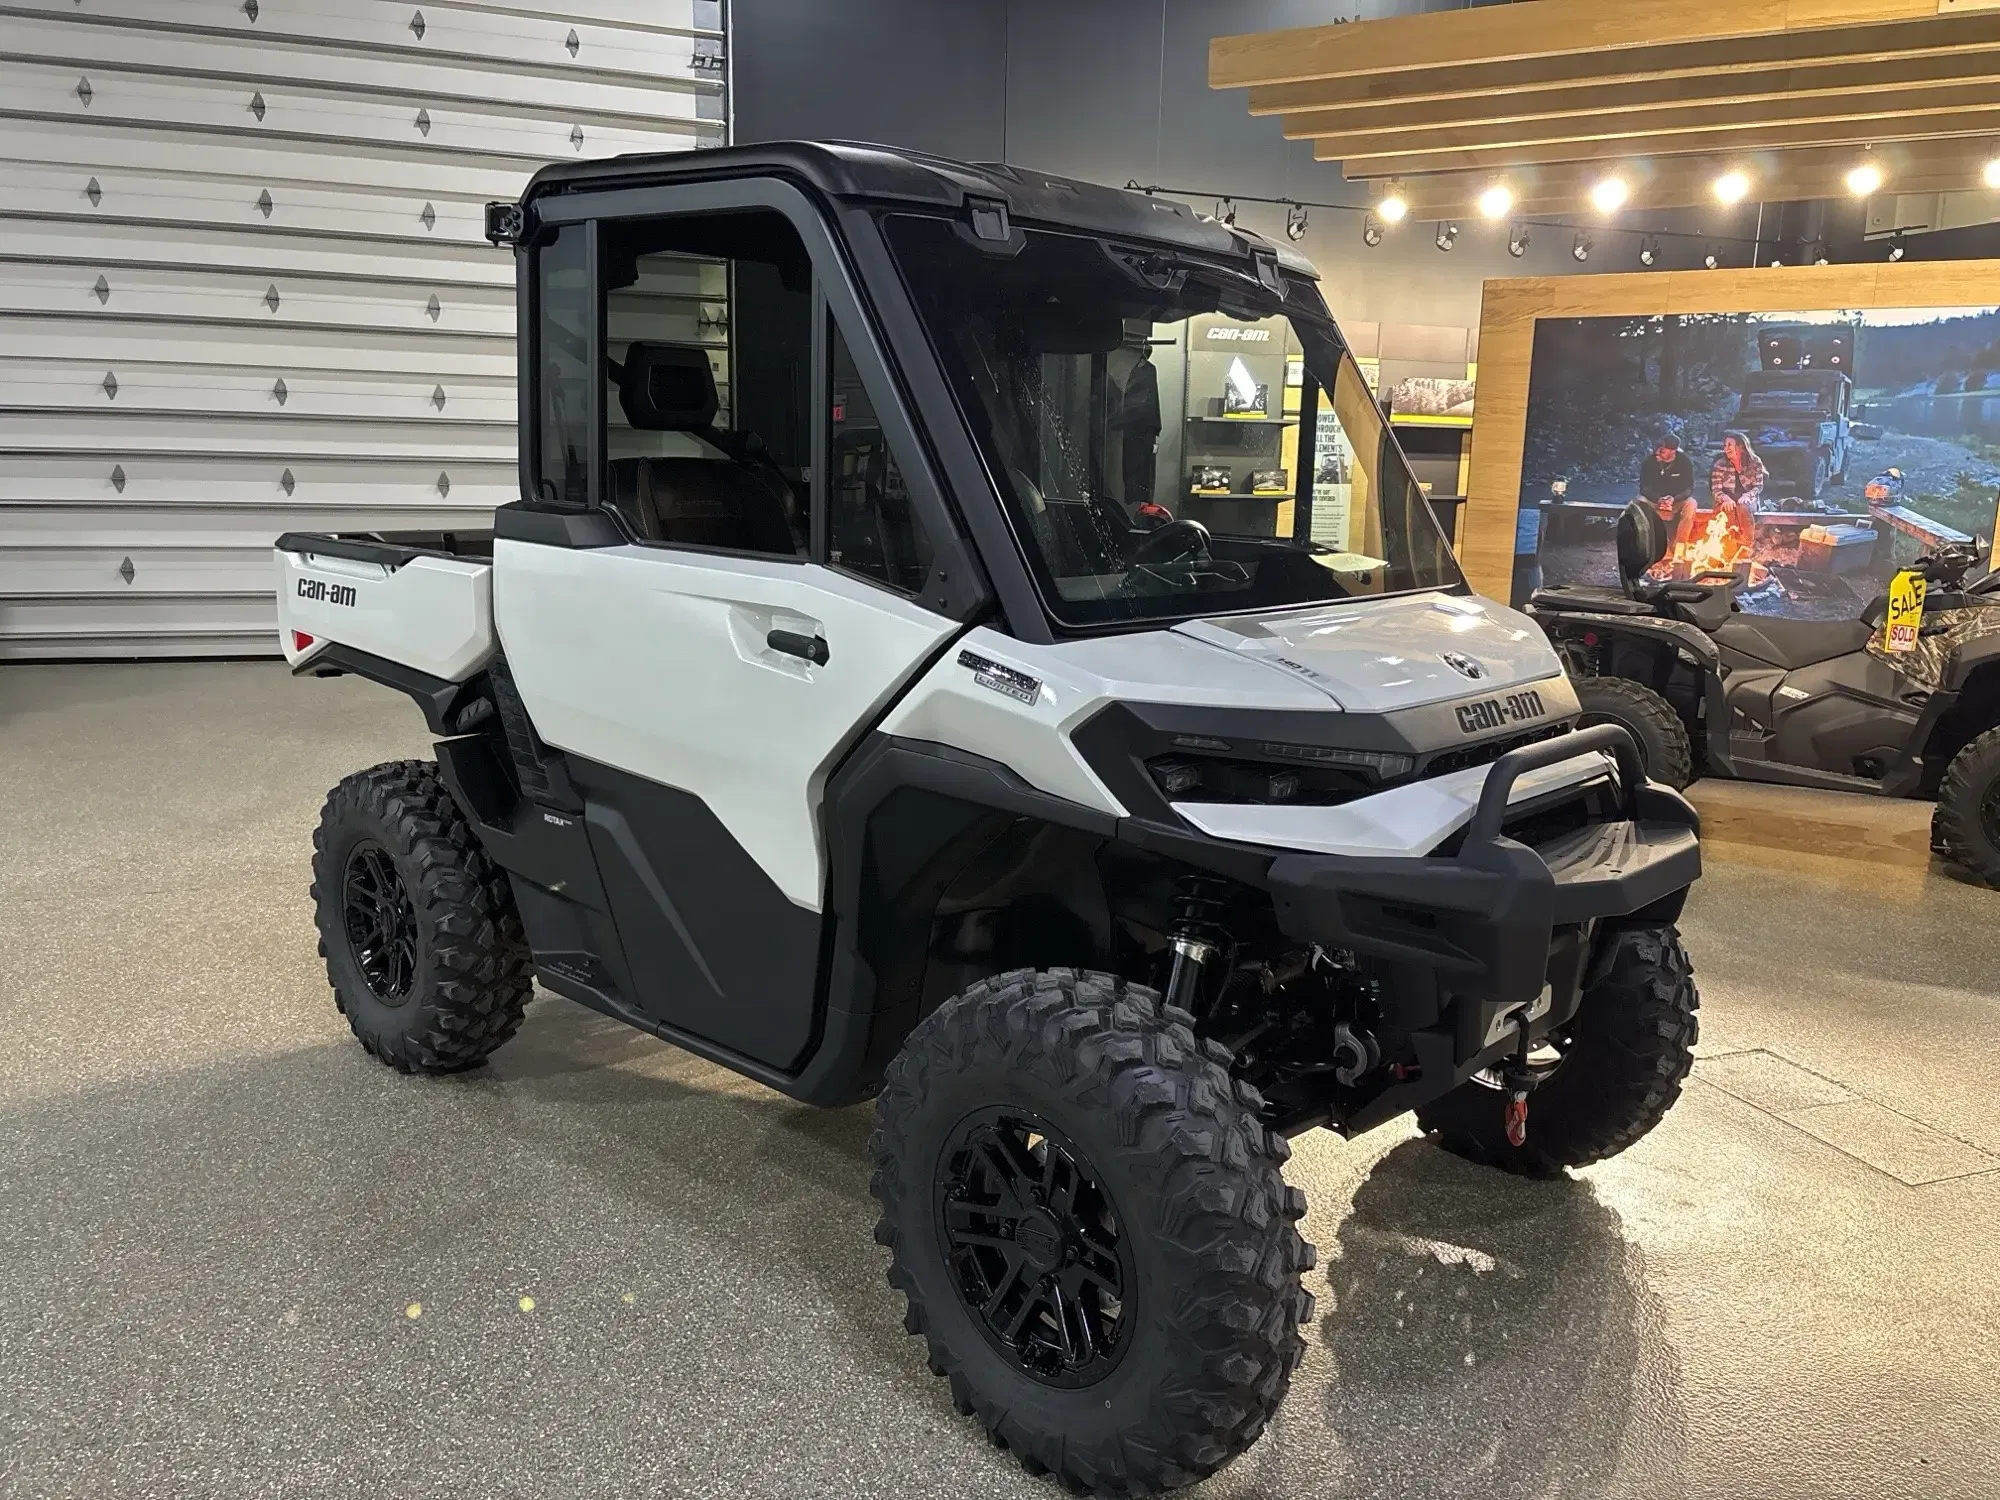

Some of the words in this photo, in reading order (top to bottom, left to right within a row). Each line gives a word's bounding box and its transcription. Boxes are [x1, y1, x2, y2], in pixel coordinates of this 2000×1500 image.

[1206, 327, 1270, 342] can-am
[1317, 415, 1335, 423] OWER
[1316, 424, 1342, 433] HROUGH
[1325, 435, 1335, 443] THE
[1315, 444, 1342, 453] LEMENTS
[297, 577, 357, 608] can-am
[1891, 584, 1922, 620] SALE
[1891, 626, 1914, 642] SOLD
[1454, 690, 1546, 734] can-am
